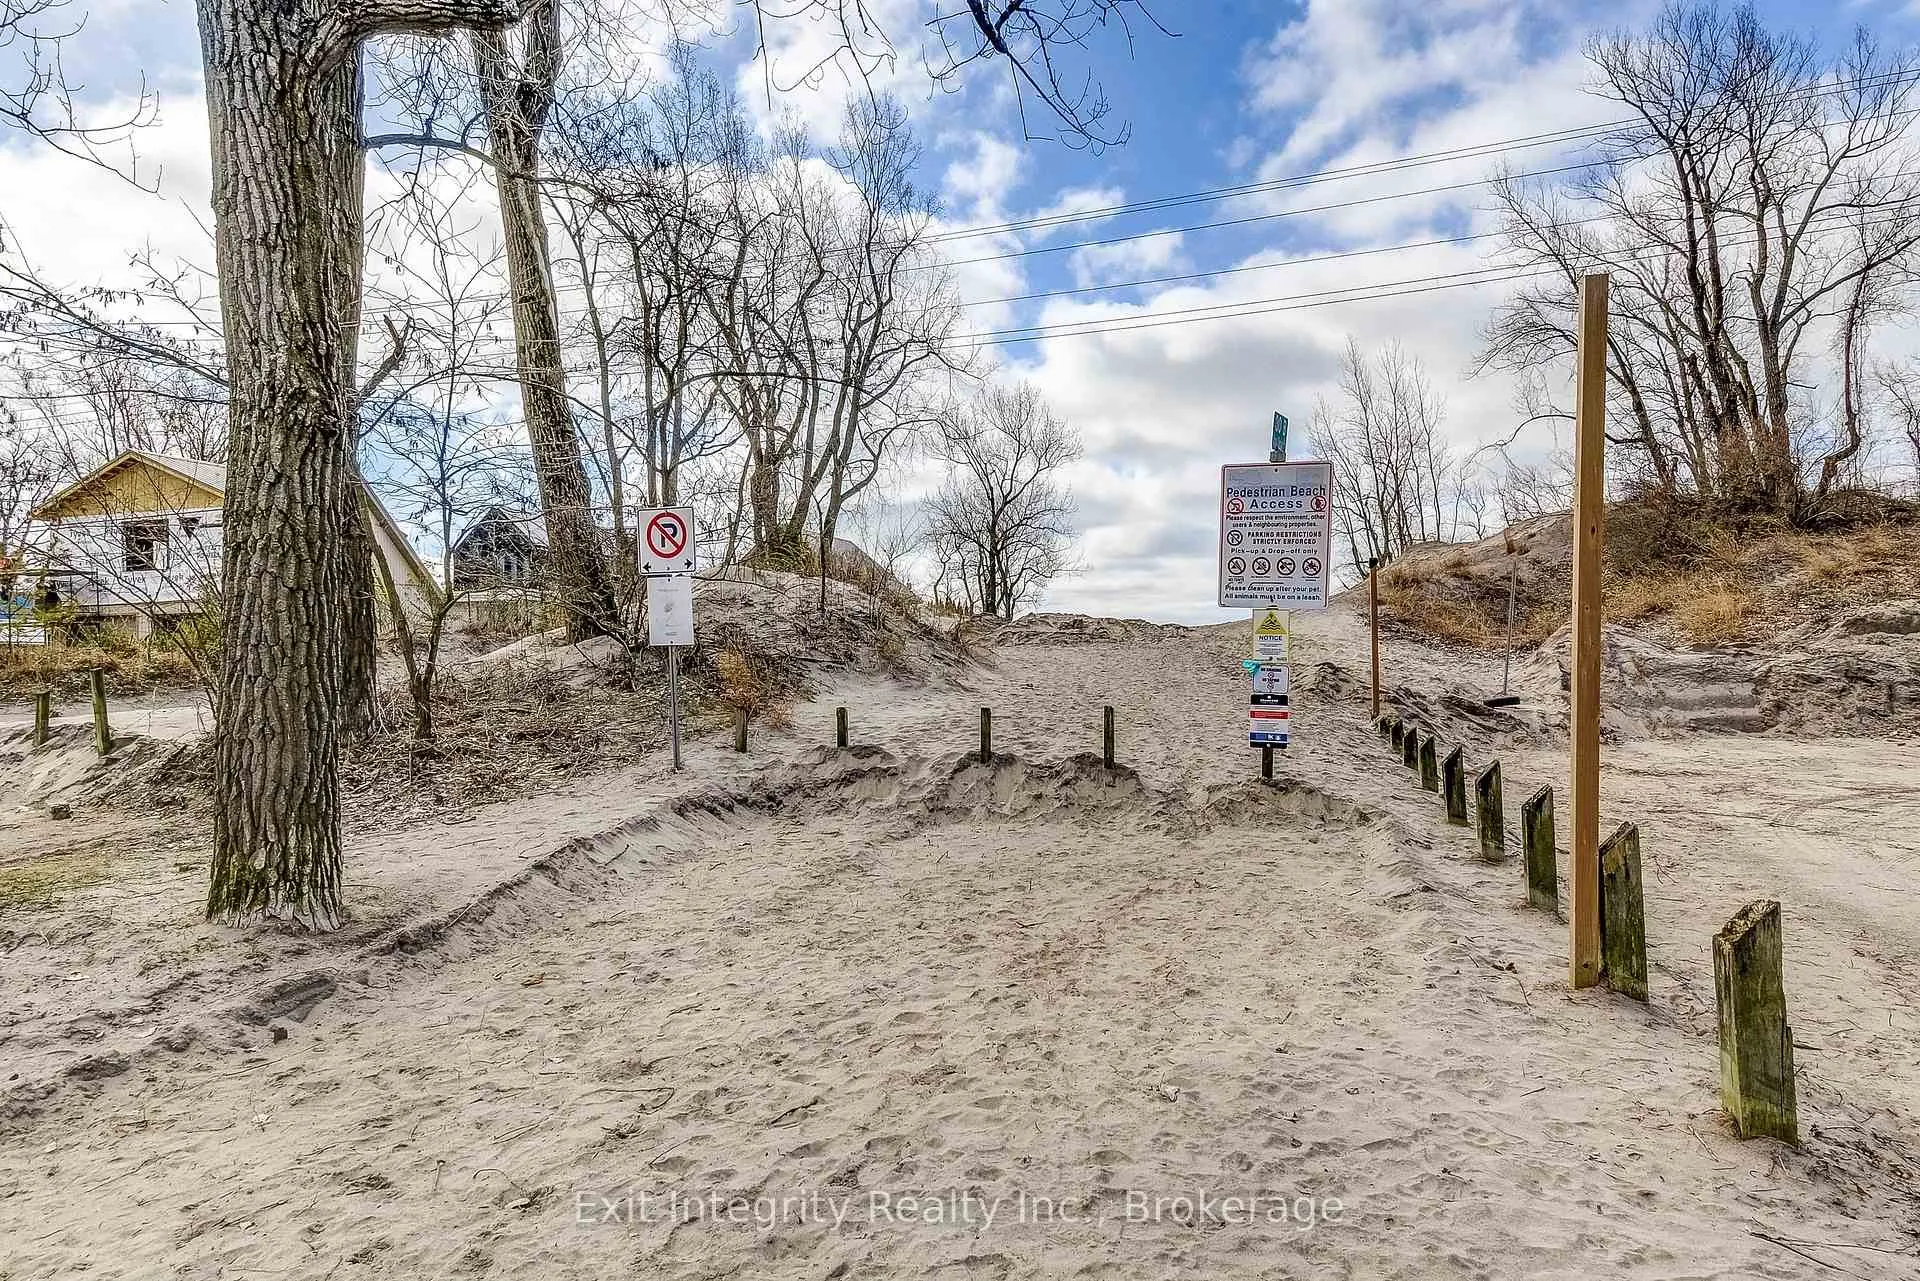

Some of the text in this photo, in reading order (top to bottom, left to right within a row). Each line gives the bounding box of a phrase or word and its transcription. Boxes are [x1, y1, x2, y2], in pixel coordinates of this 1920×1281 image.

[1226, 485, 1326, 498] Pedestrian Beach
[1249, 499, 1303, 509] Access
